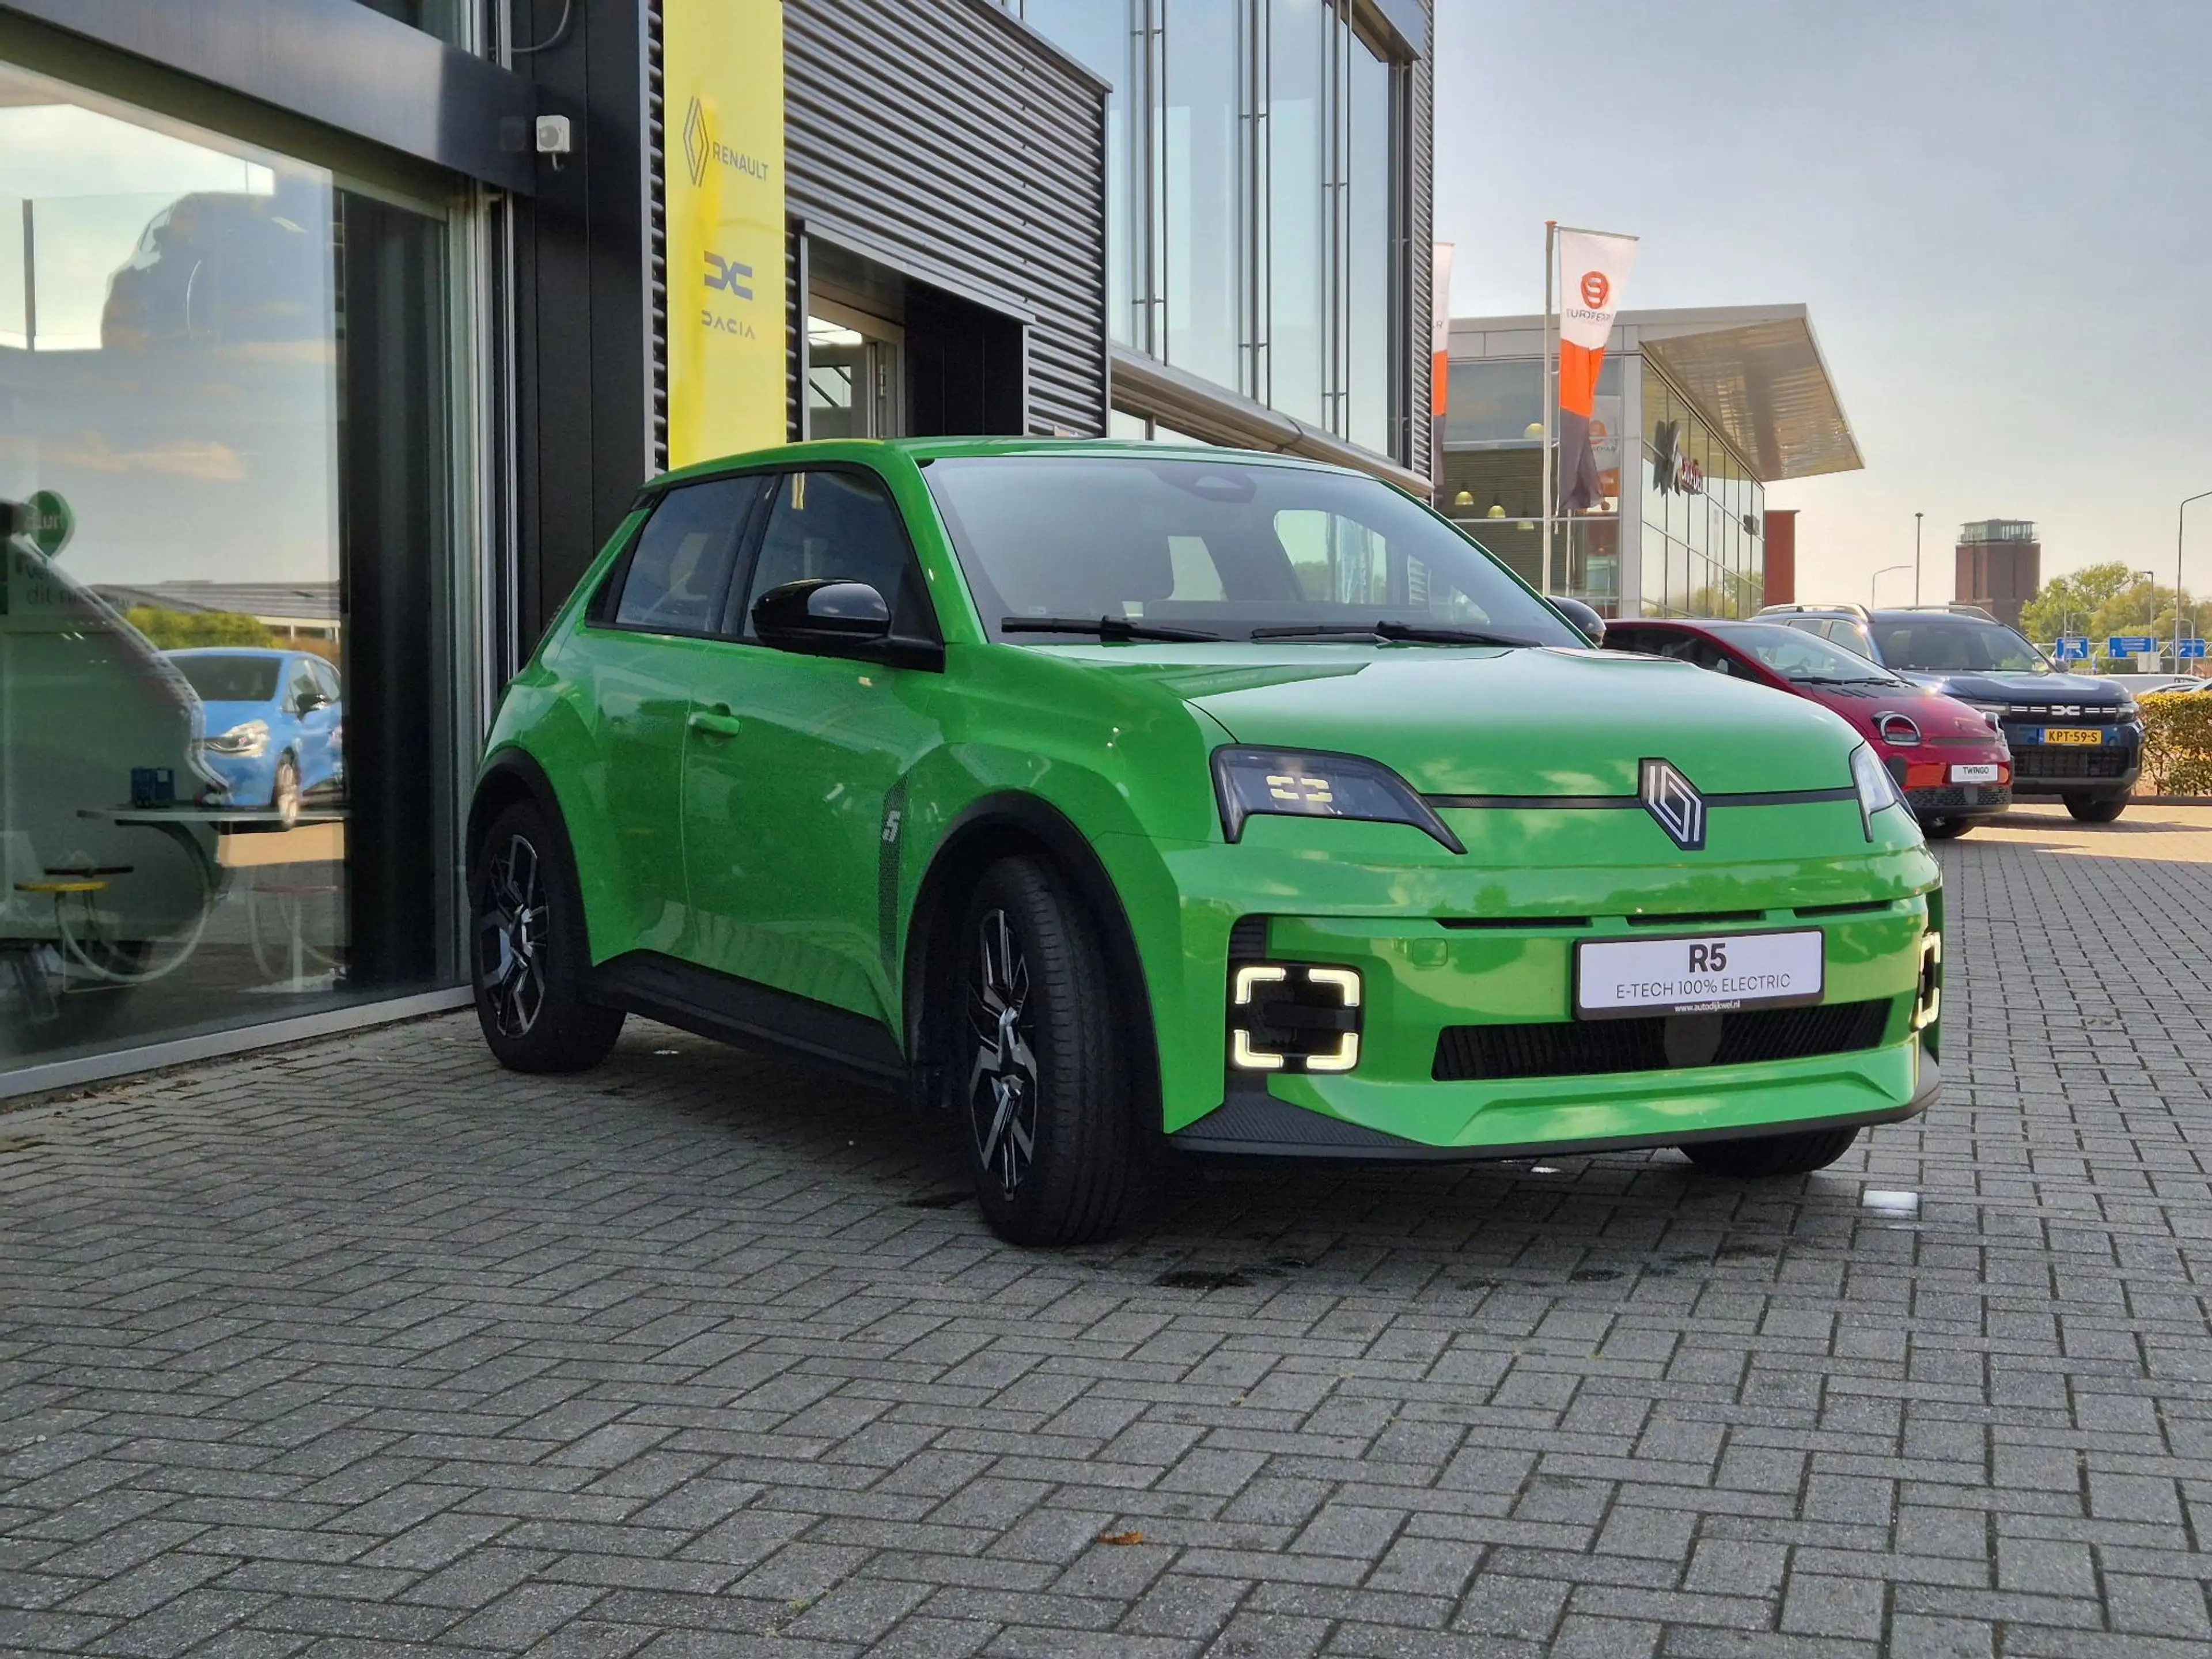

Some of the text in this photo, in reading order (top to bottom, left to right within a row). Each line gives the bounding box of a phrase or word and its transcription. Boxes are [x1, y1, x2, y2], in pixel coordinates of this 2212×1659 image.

[713, 141, 768, 181] RENAULT
[701, 309, 756, 340] DACIA
[2048, 730, 2098, 743] KPT-59-S
[1963, 766, 1990, 775] TWINGO
[1688, 942, 1728, 974] R5
[1616, 974, 1791, 999] E-TECH 100% ELECTRIC
